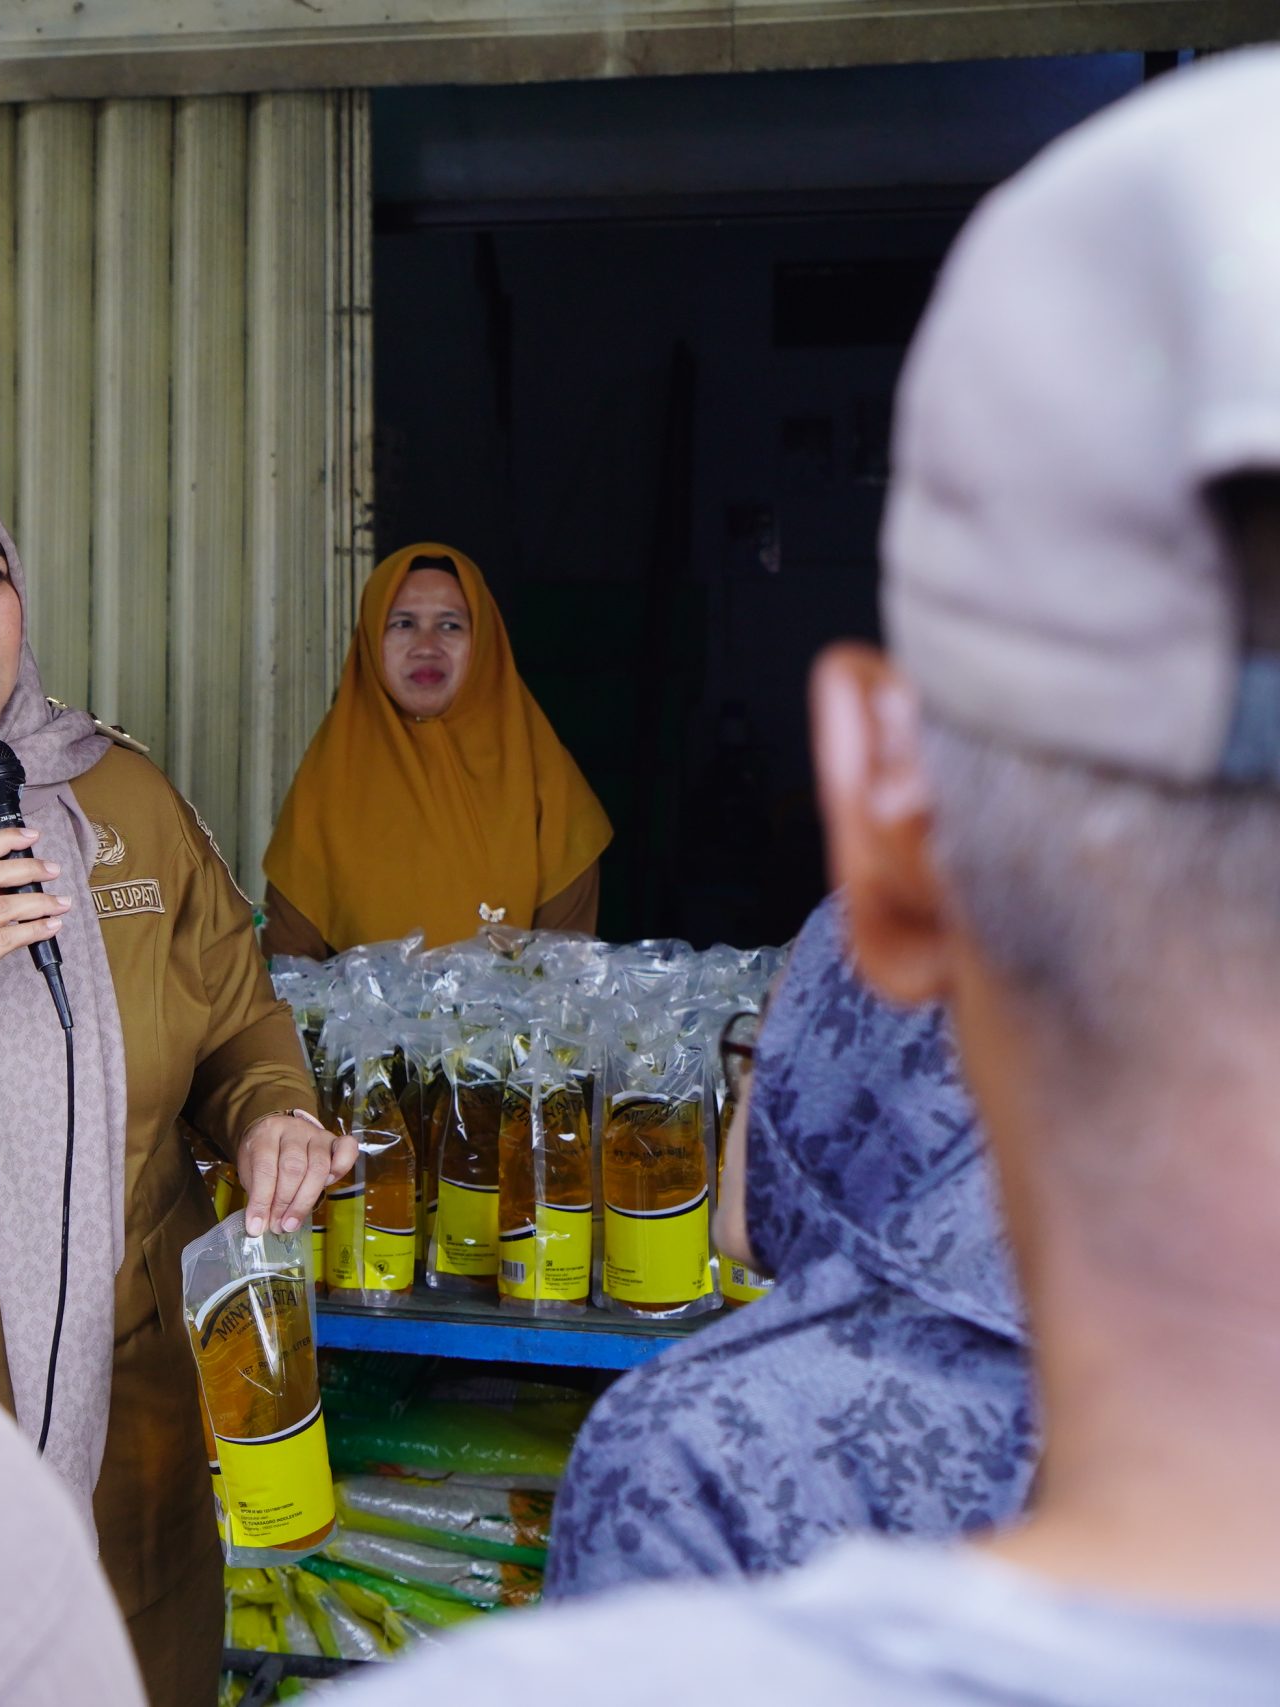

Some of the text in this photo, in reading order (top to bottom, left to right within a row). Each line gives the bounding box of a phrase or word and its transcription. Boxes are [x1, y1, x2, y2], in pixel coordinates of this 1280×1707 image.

[92, 885, 158, 912] IL BUPATI
[215, 1289, 298, 1342] MINYKITA
